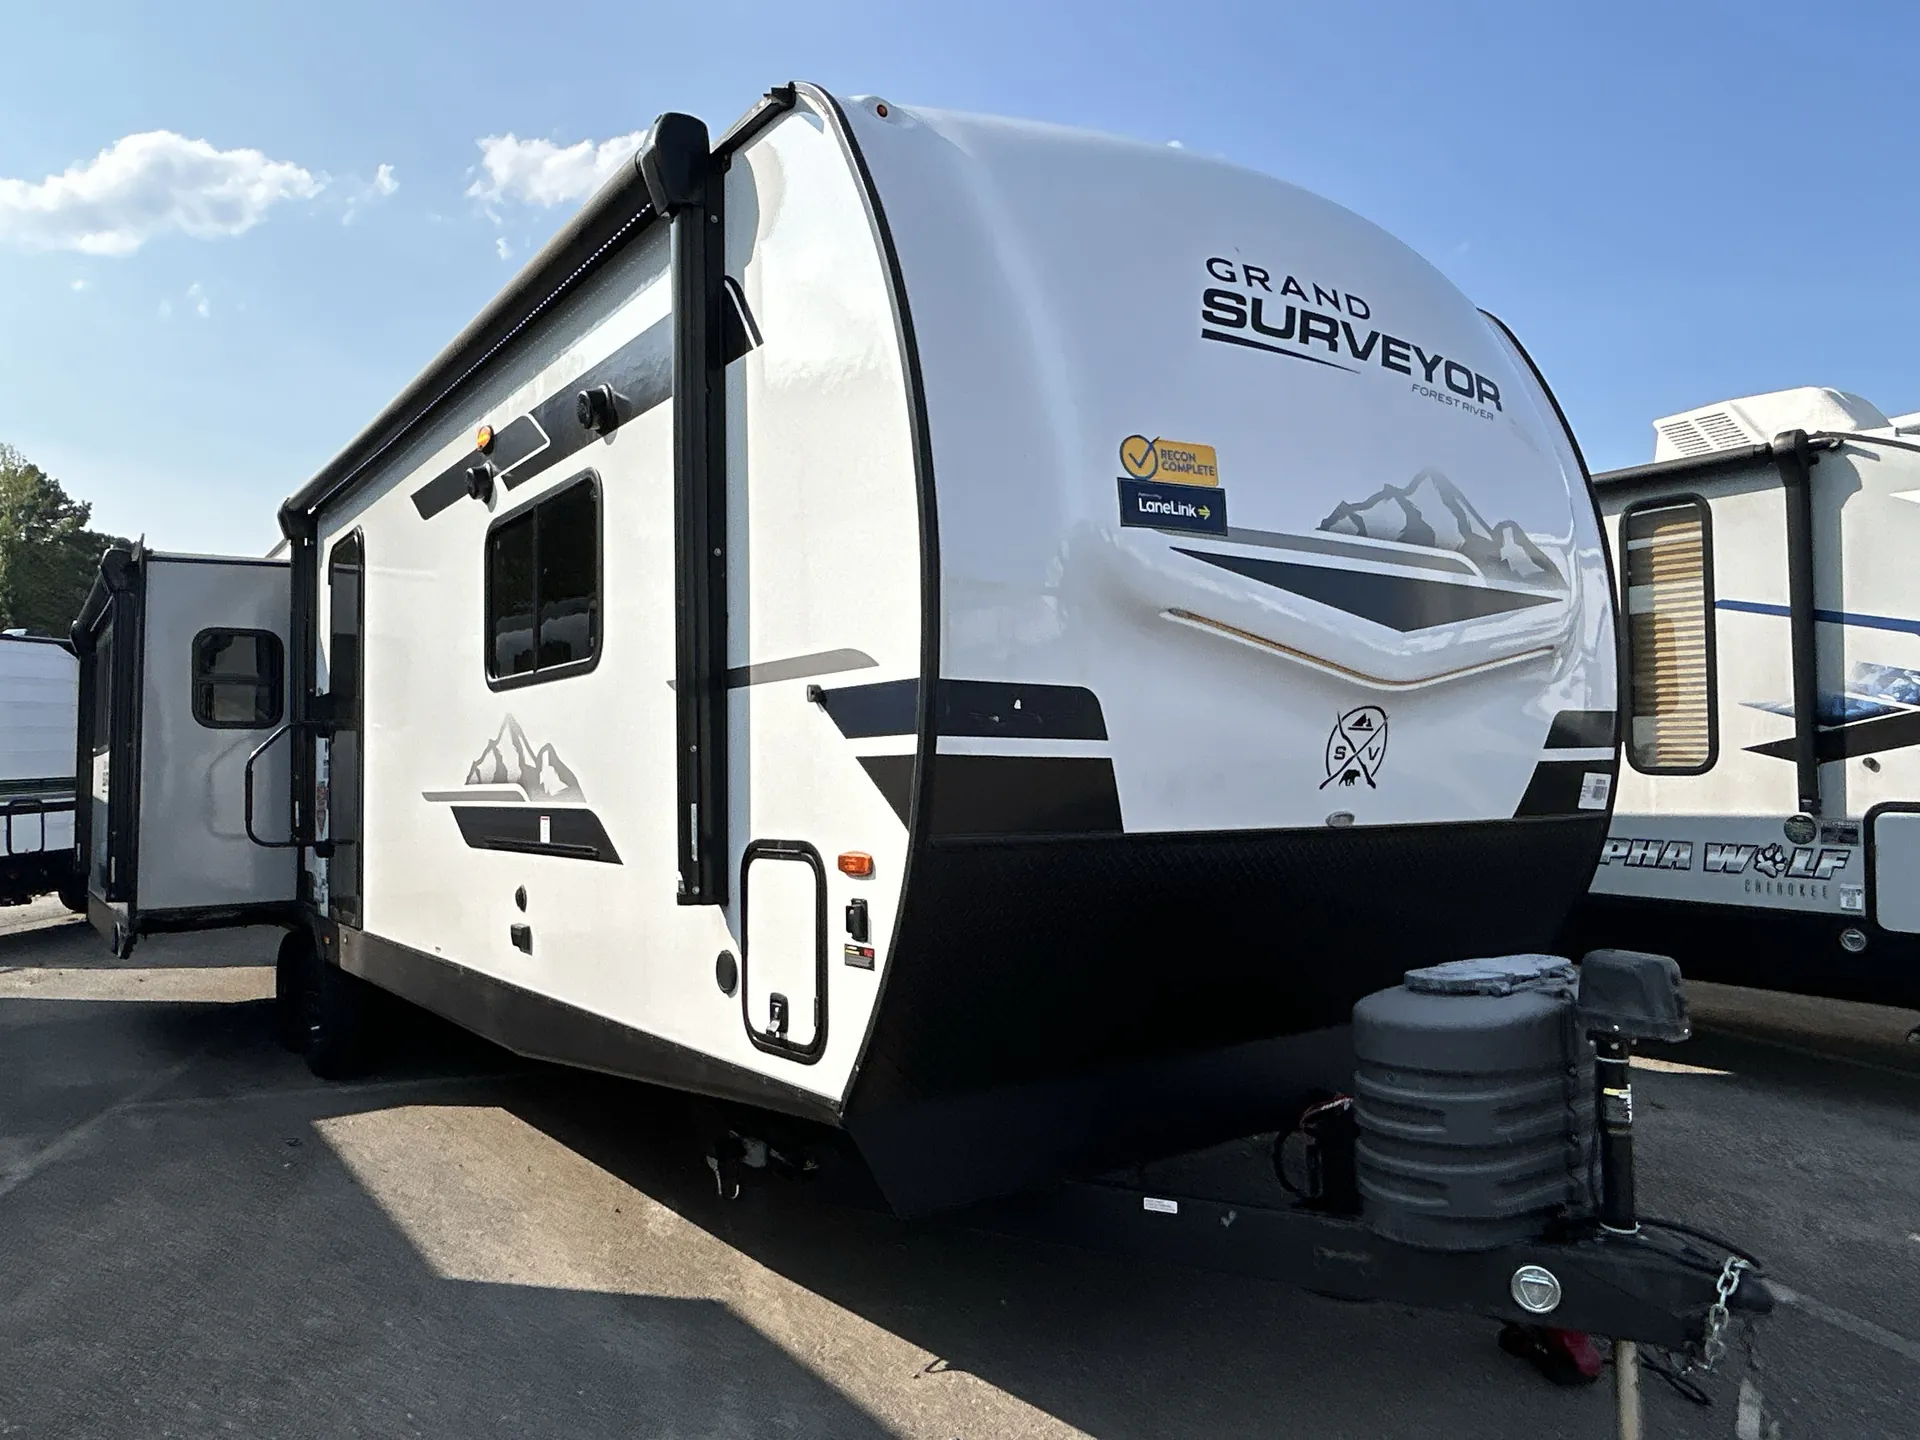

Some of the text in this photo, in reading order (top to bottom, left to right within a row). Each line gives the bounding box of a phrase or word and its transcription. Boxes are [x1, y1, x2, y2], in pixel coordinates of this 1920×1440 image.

[1205, 257, 1371, 320] GRAND
[1202, 288, 1503, 412] SURVEYOR
[1411, 383, 1495, 421] FOREST RIVER
[1160, 448, 1197, 463] RECON
[1161, 461, 1215, 476] COMPLETE
[1138, 497, 1197, 518] LaneLink
[1333, 745, 1380, 761] S V
[1744, 879, 1829, 901] CHEROKEE
